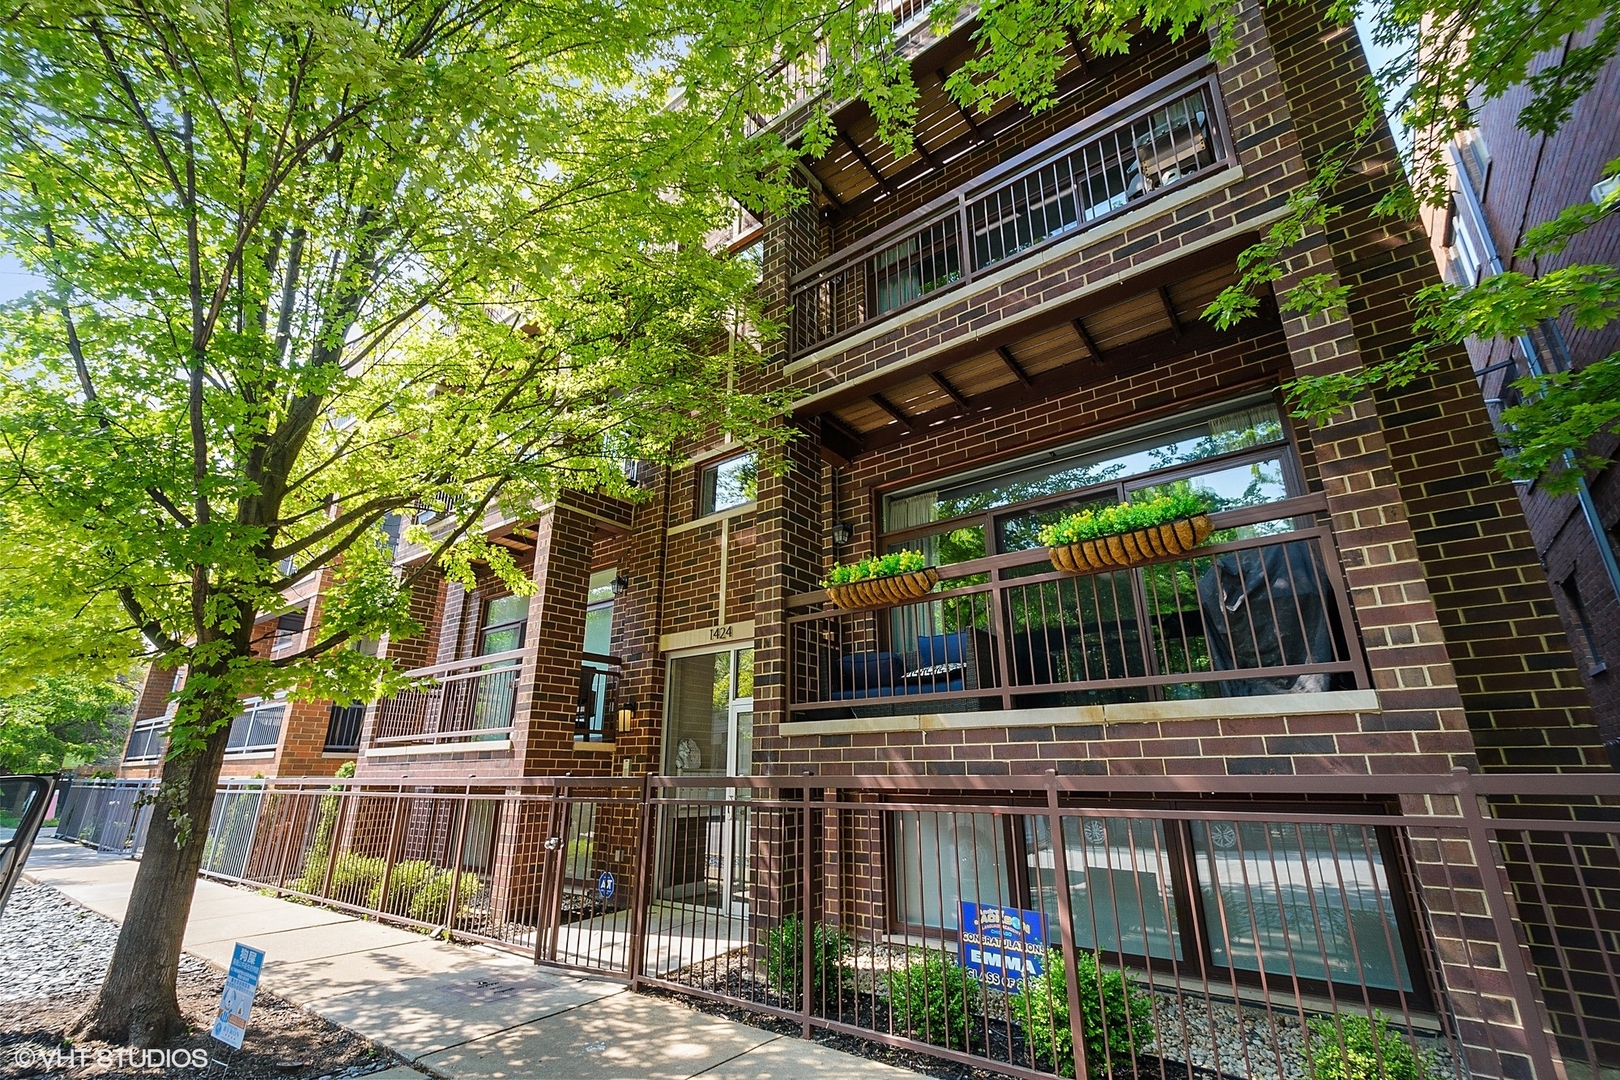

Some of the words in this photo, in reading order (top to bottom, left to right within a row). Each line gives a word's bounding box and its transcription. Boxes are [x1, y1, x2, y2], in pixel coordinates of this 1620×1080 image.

[710, 626, 732, 640] 1424
[600, 880, 612, 889] AT
[962, 932, 1045, 956] CONGRATULATONS
[971, 949, 1037, 975] EMMA
